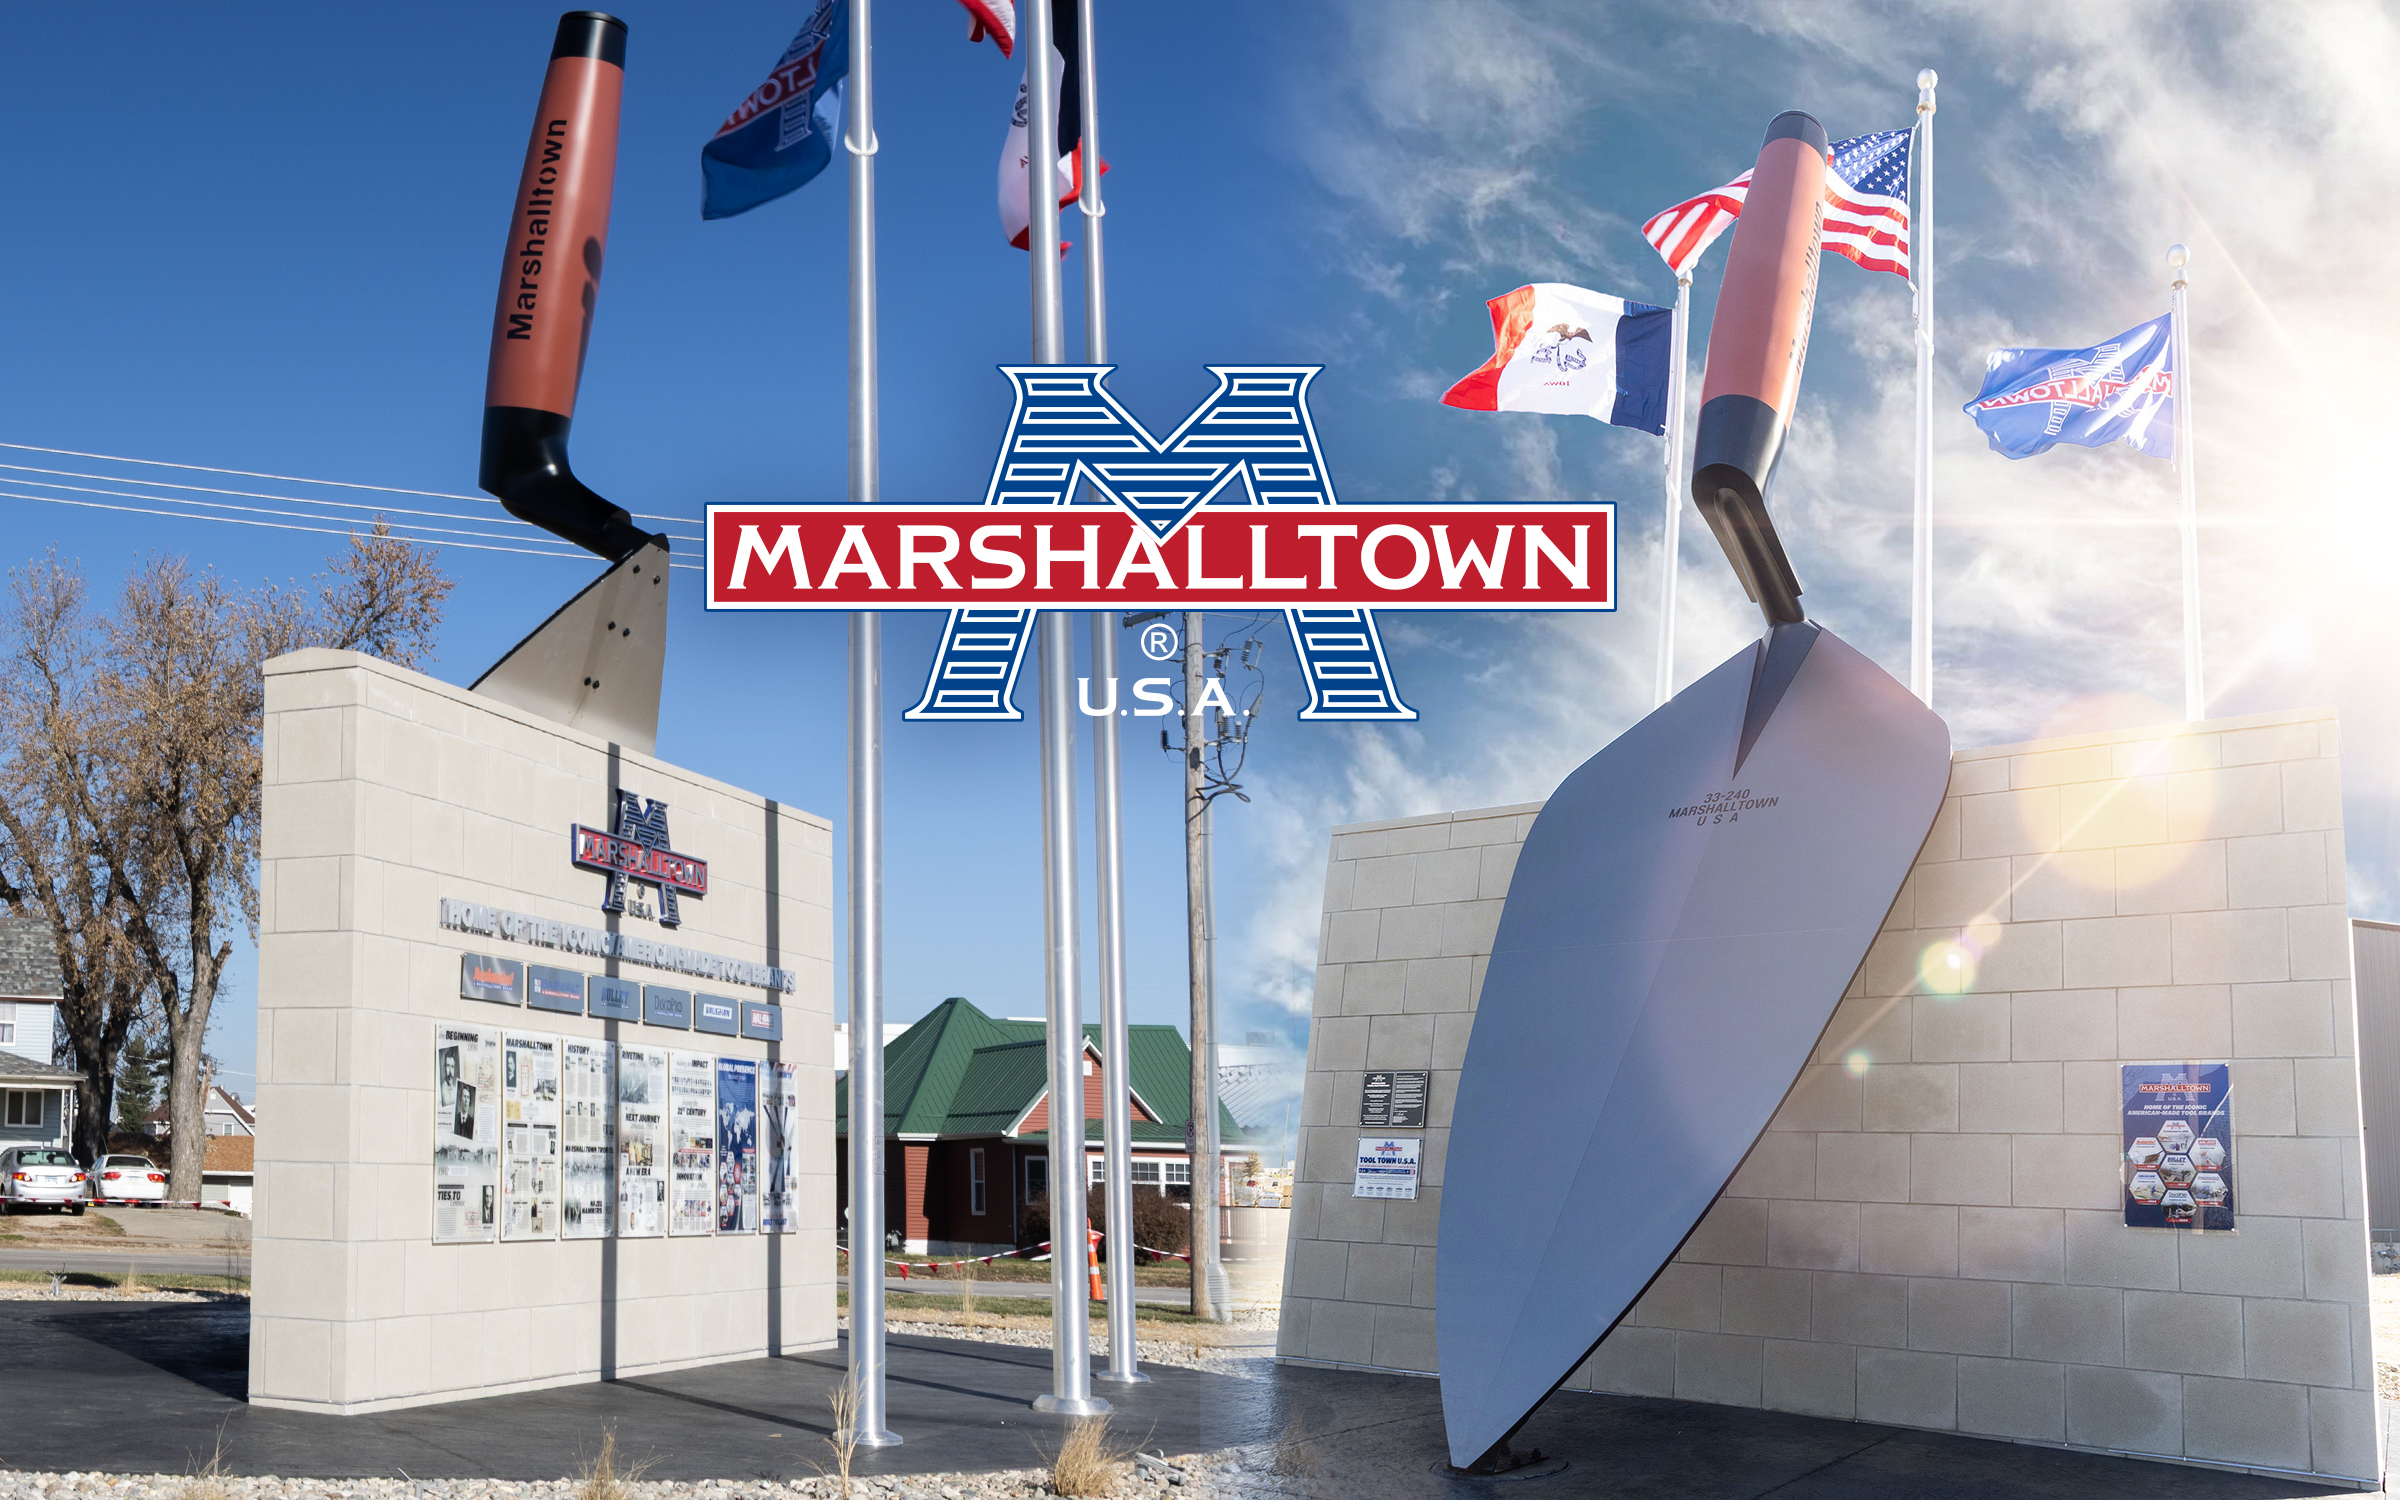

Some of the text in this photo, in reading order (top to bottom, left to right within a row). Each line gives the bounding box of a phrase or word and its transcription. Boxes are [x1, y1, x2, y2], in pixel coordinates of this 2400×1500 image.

[506, 119, 568, 341] Marshalltown
[1704, 789, 1751, 804] 33-240
[1668, 797, 1779, 819] MARSHALLTOWN
[581, 833, 706, 888] MARSHALLTOWN
[449, 900, 796, 992] HOME OF THE ICONIC AMERICAN-MADE TOOL BRANDS
[542, 979, 580, 993] BARWALT
[601, 987, 630, 1004] BULLET
[705, 1005, 730, 1018] VAUGHAN
[446, 1030, 478, 1043] BEGINNING
[506, 1038, 553, 1051] MARSHALLTOWN
[567, 1044, 590, 1056] HISTORY
[621, 1050, 644, 1061] RIVETING
[691, 1059, 709, 1069] IMPACT
[718, 1062, 755, 1075] GLOBAL PRESENCE
[625, 1113, 660, 1124] NEXT JOURNEY
[686, 1107, 707, 1117] CENTURY
[1360, 1156, 1417, 1165] TOOL TOWN U.S.A.
[676, 1172, 702, 1181] INNOVATION
[438, 1190, 461, 1201] TIES TO
